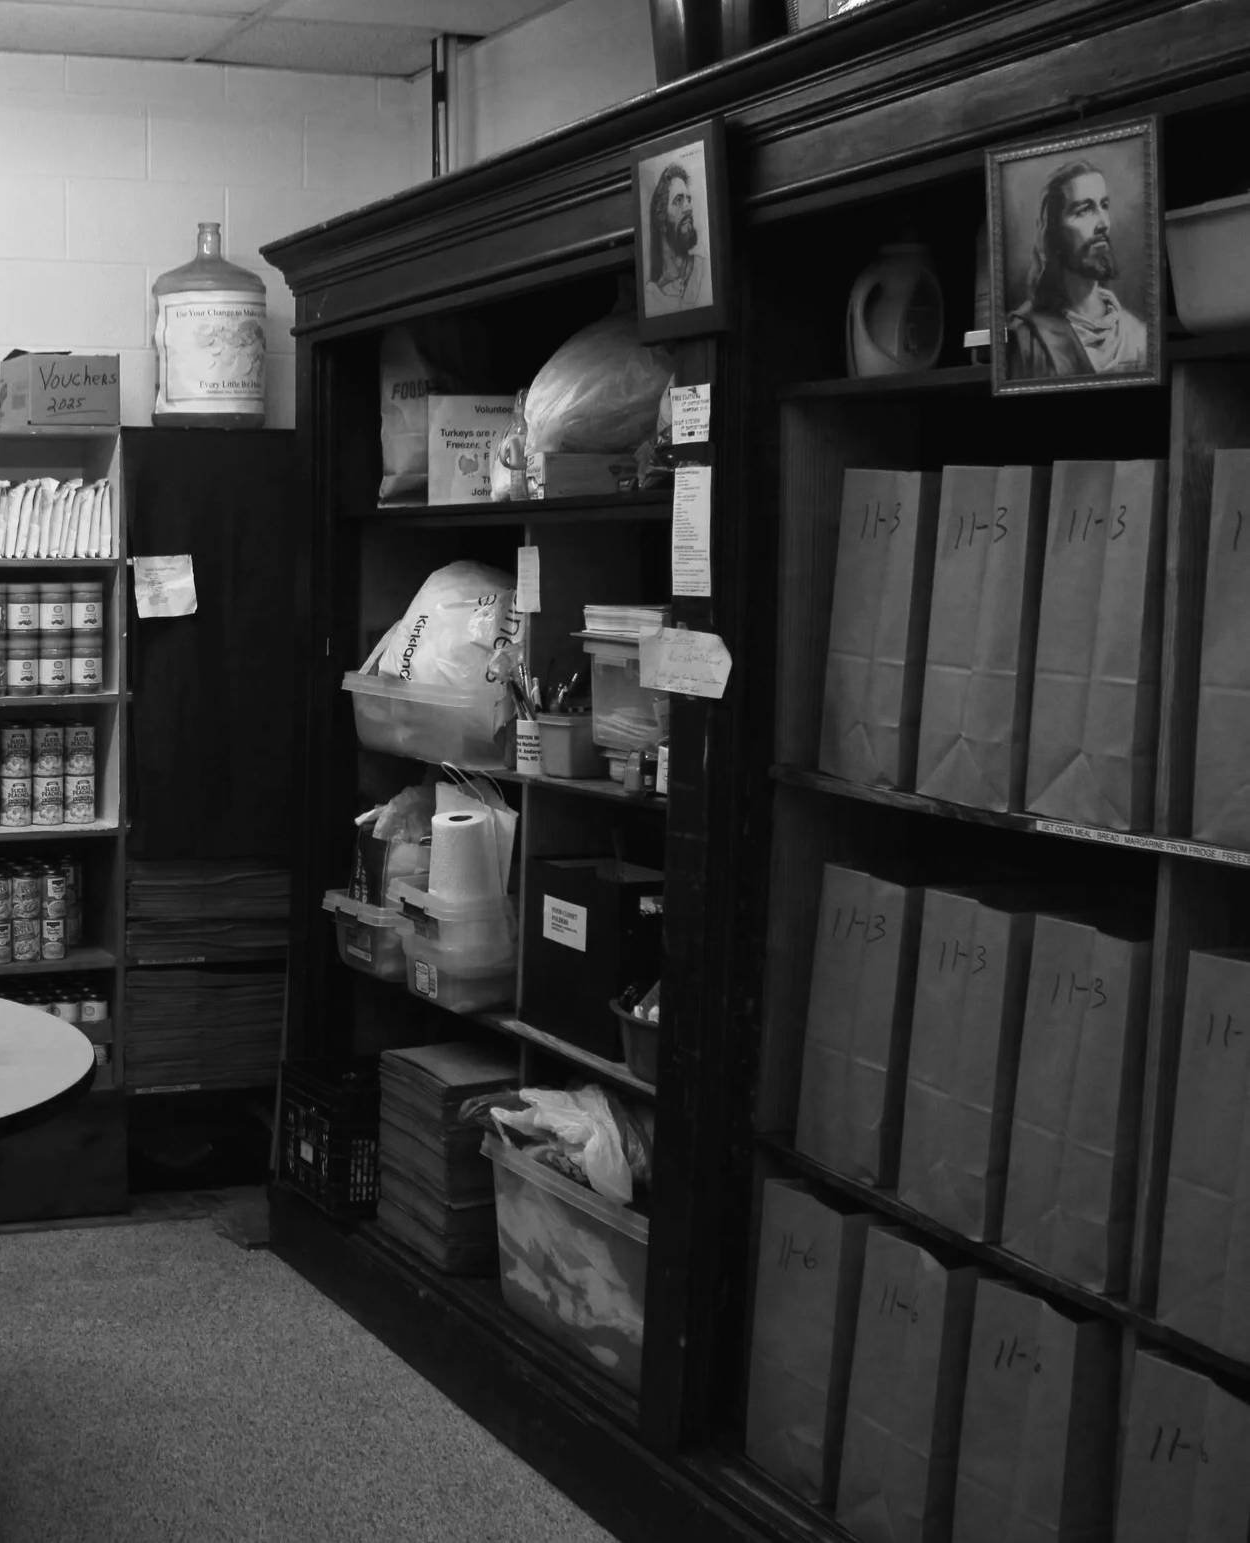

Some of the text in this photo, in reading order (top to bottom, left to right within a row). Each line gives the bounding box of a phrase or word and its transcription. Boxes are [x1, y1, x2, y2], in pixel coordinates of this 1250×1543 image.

[188, 308, 206, 318] Your
[206, 307, 235, 319] Change
[199, 380, 220, 391] Every
[221, 380, 240, 389] Little
[46, 397, 86, 414] 2025
[440, 428, 475, 440] Turkeys
[476, 430, 490, 438] are
[860, 501, 902, 540] 11-3
[954, 506, 1009, 550] 11-3
[1068, 505, 1127, 543] 11-3
[1041, 822, 1055, 832] GET
[1055, 825, 1074, 835] CORN
[1074, 828, 1092, 838] MEAL
[1096, 832, 1120, 843] BREAD
[1124, 836, 1165, 850] MARGARINE
[1166, 843, 1188, 854] FROM
[1189, 846, 1217, 859] FRIDGE
[832, 907, 887, 943] 11-3
[939, 939, 987, 975] 11-3
[1052, 973, 1107, 1009] 11-3
[778, 1232, 817, 1270] 11-6
